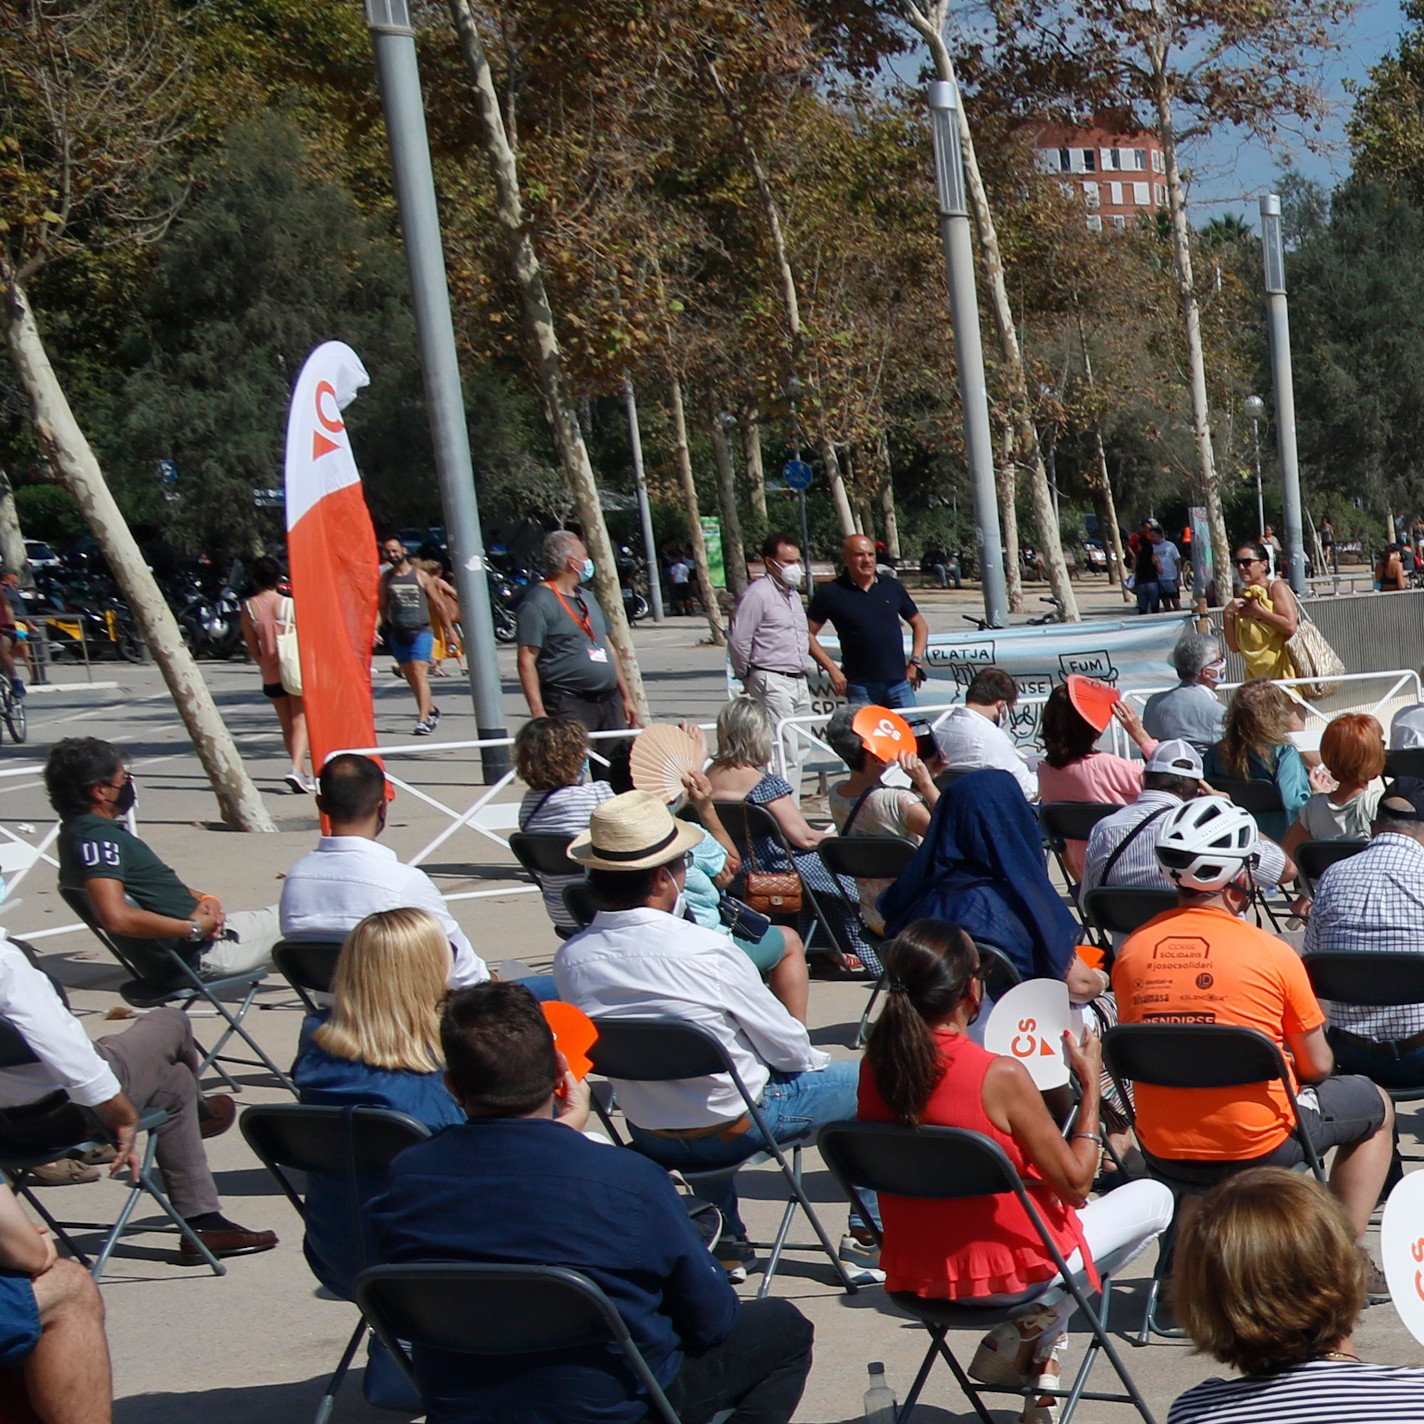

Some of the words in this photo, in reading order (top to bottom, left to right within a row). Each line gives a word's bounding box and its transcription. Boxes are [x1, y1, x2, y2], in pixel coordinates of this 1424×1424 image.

[932, 649, 990, 661] PLATJA
[1069, 659, 1103, 672] FUM
[1011, 1018, 1037, 1058] Cs
